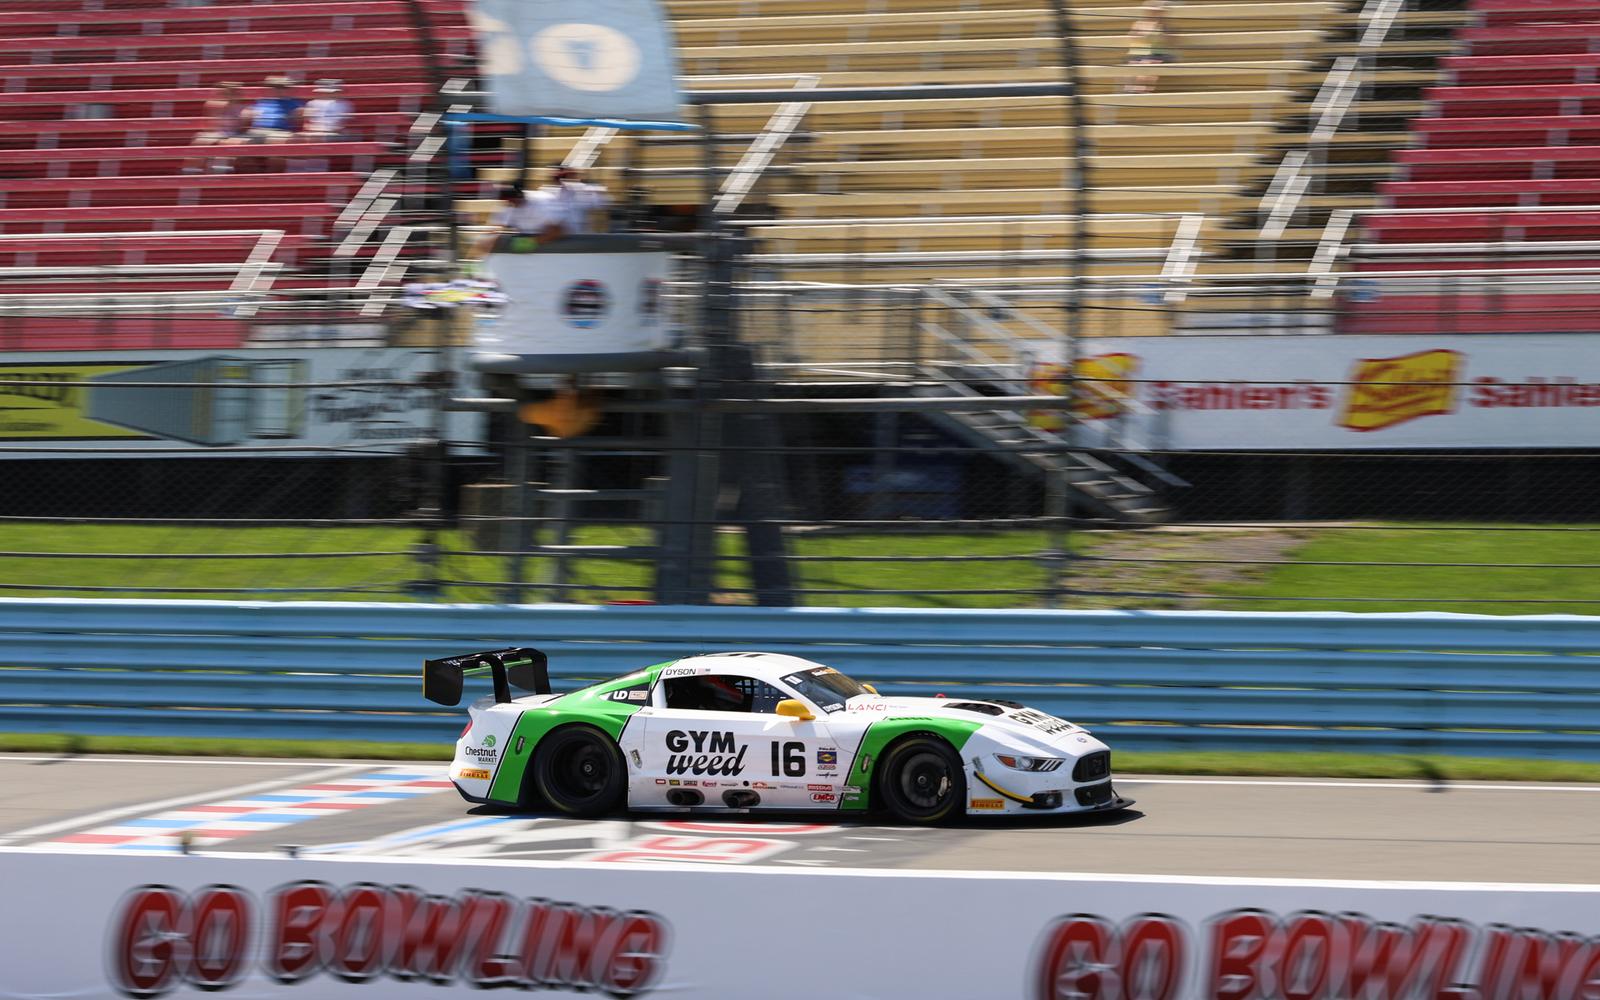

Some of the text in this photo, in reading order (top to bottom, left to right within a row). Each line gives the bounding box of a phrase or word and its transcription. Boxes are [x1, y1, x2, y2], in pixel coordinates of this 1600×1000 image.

[665, 668, 697, 676] DYSON
[847, 703, 887, 711] LANCI
[465, 745, 497, 757] Chestnut
[665, 729, 736, 754] GYM
[665, 744, 749, 777] weed
[771, 740, 806, 777] 16
[109, 879, 673, 999] GO BOWLING
[1026, 912, 1197, 1000] GO
